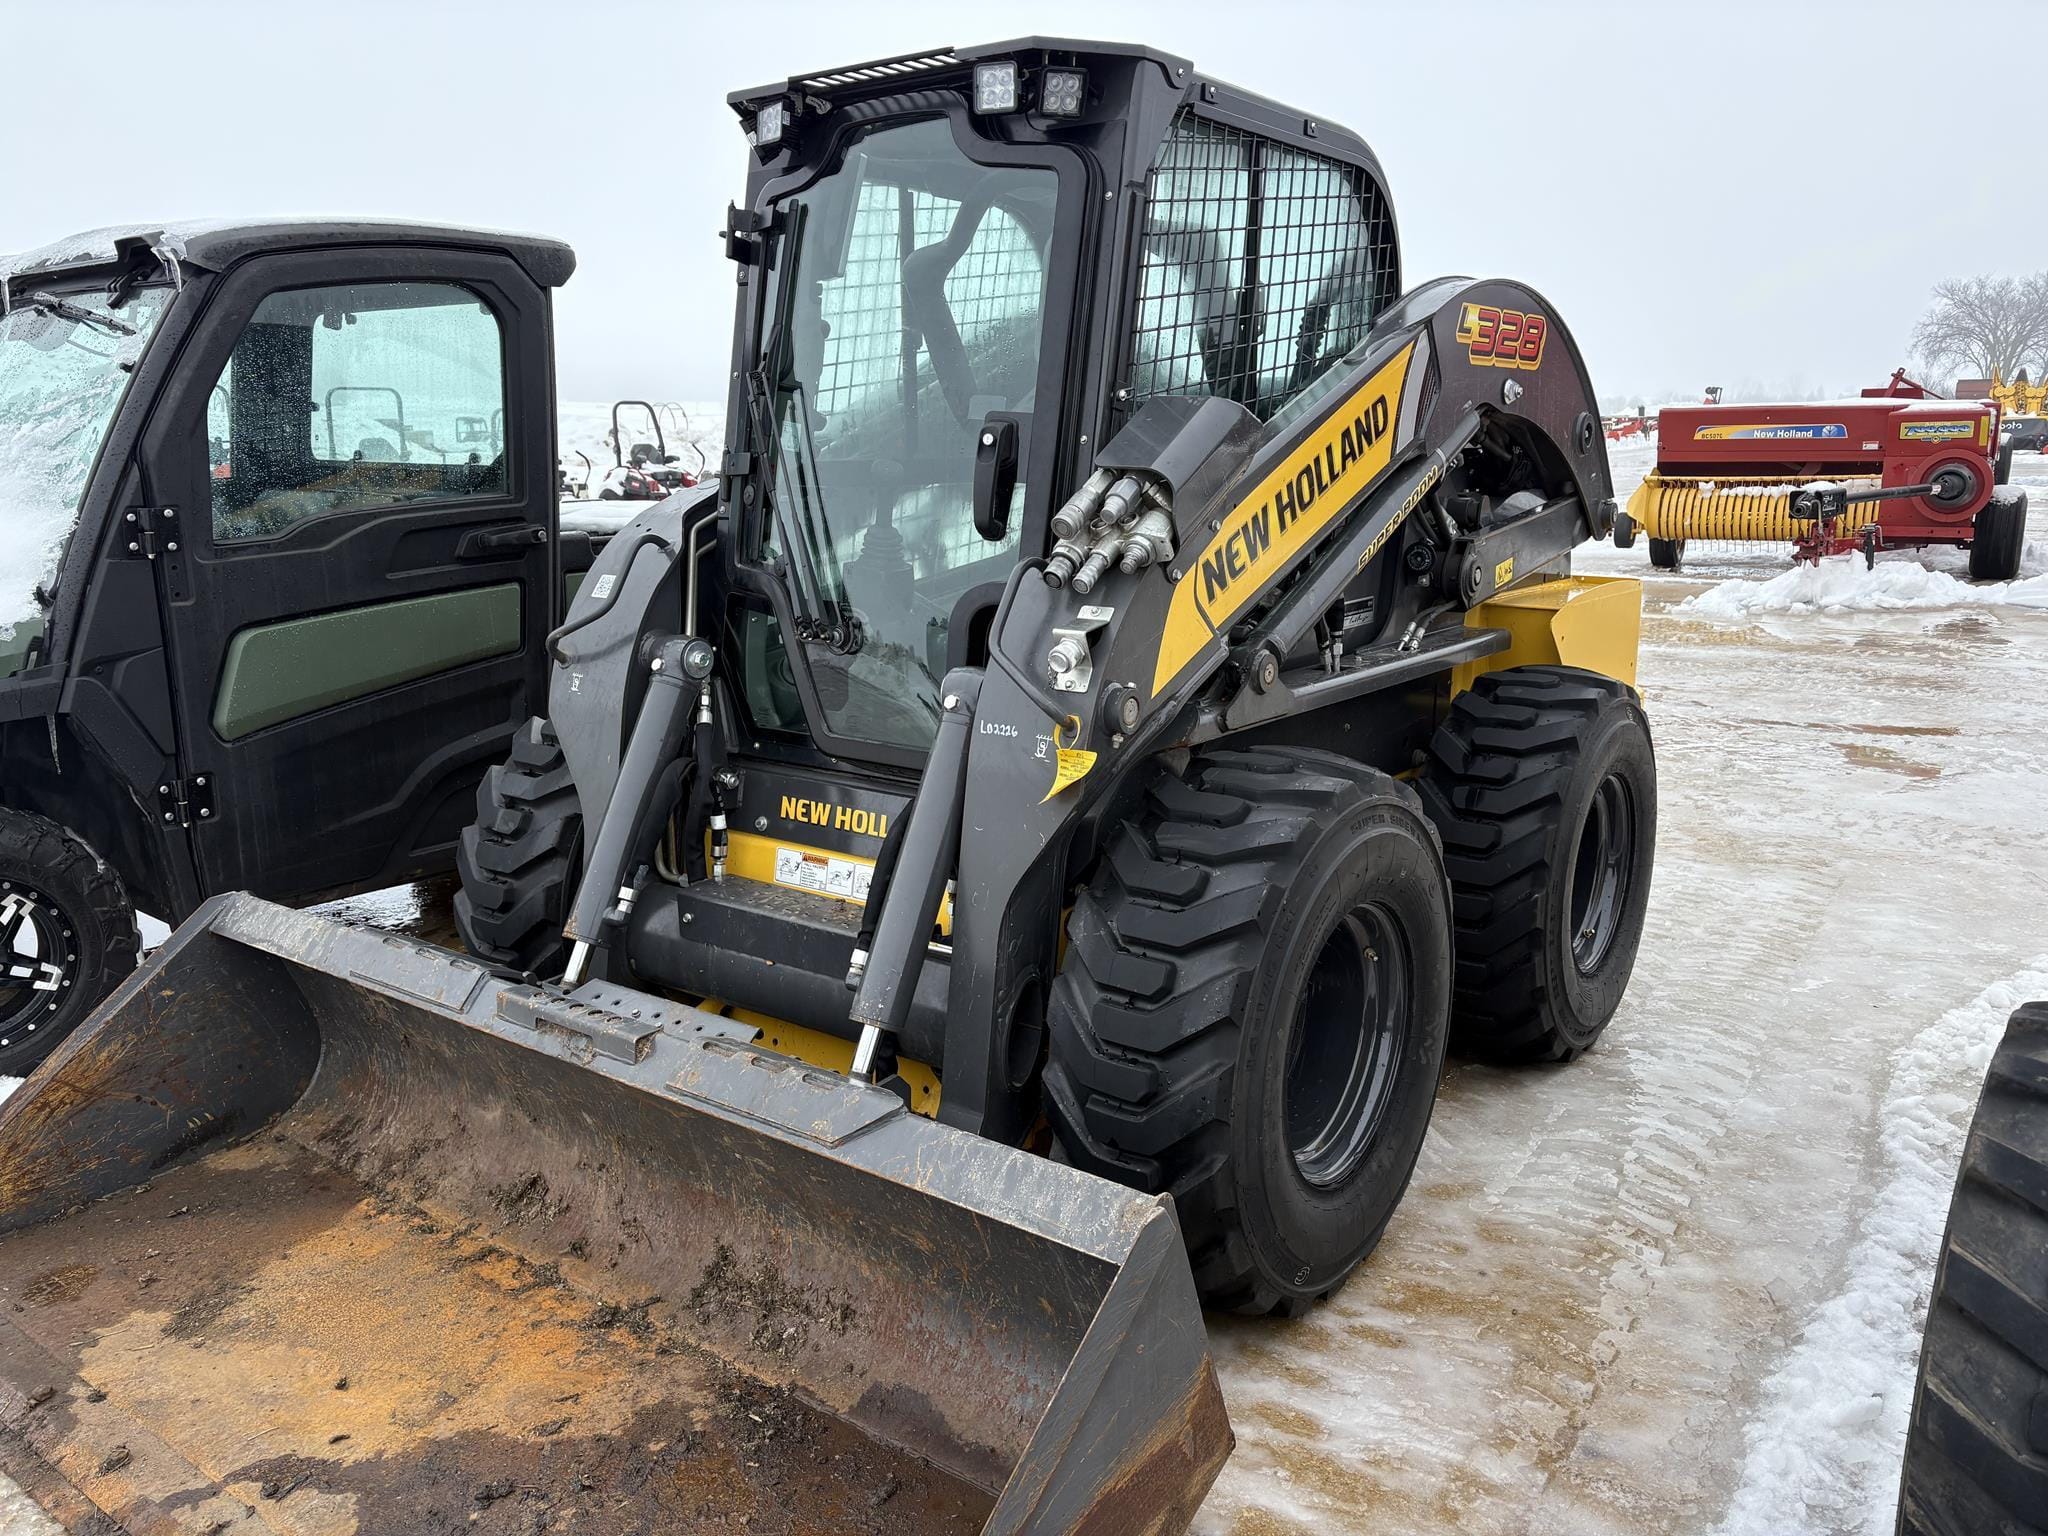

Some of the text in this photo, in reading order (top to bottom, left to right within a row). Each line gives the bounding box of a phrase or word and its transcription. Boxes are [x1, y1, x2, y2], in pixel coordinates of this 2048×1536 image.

[1456, 302, 1546, 370] L328
[1753, 428, 1813, 438] New Holland
[1202, 393, 1390, 605] NEW HOLLAND
[780, 795, 888, 838] NEW HOLL
